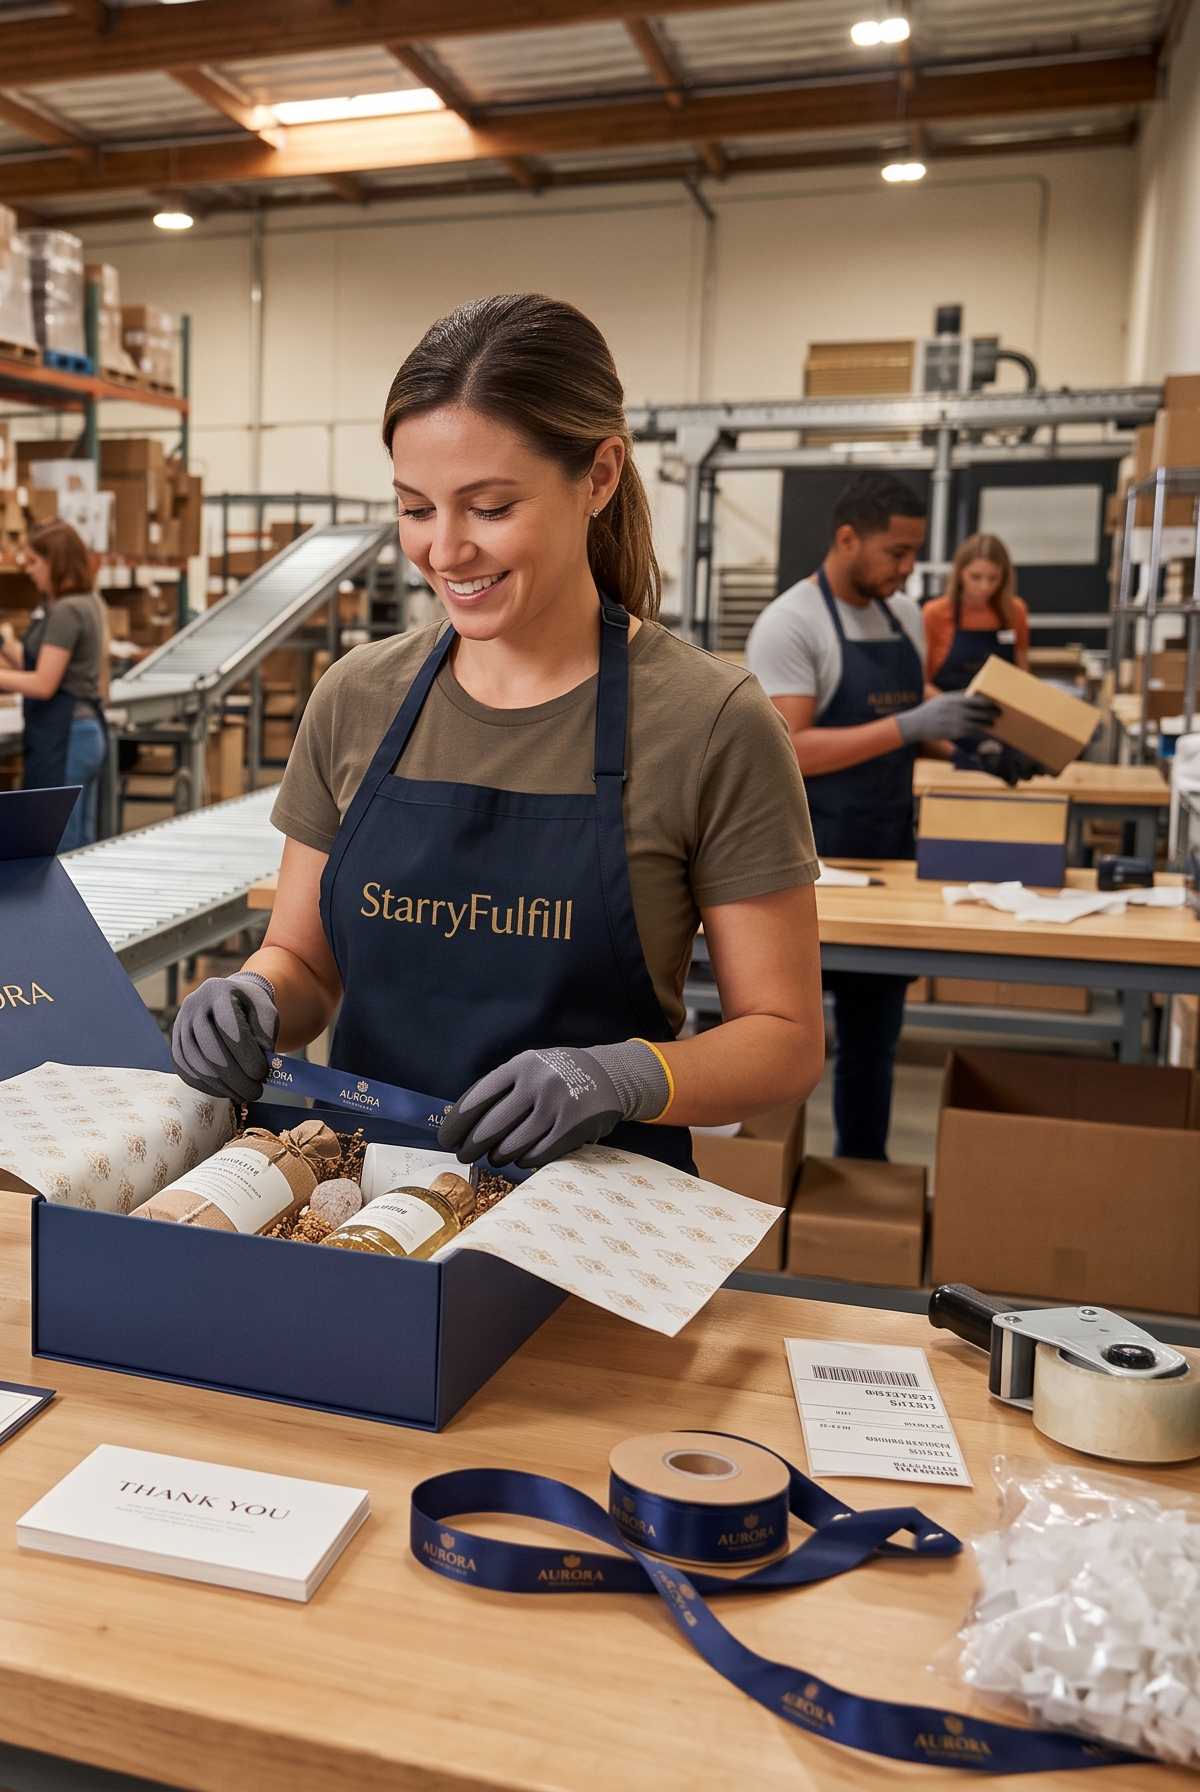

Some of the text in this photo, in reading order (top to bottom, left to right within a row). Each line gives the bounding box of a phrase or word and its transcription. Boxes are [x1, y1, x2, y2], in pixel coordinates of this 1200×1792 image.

[360, 881, 573, 940] StarryFulfill
[338, 1089, 381, 1108] AURORA
[118, 1480, 220, 1509] THANK
[229, 1499, 291, 1520] YOU
[717, 1525, 775, 1546] AURORA
[423, 1540, 477, 1572] AURORA
[537, 1569, 605, 1582] AURORA
